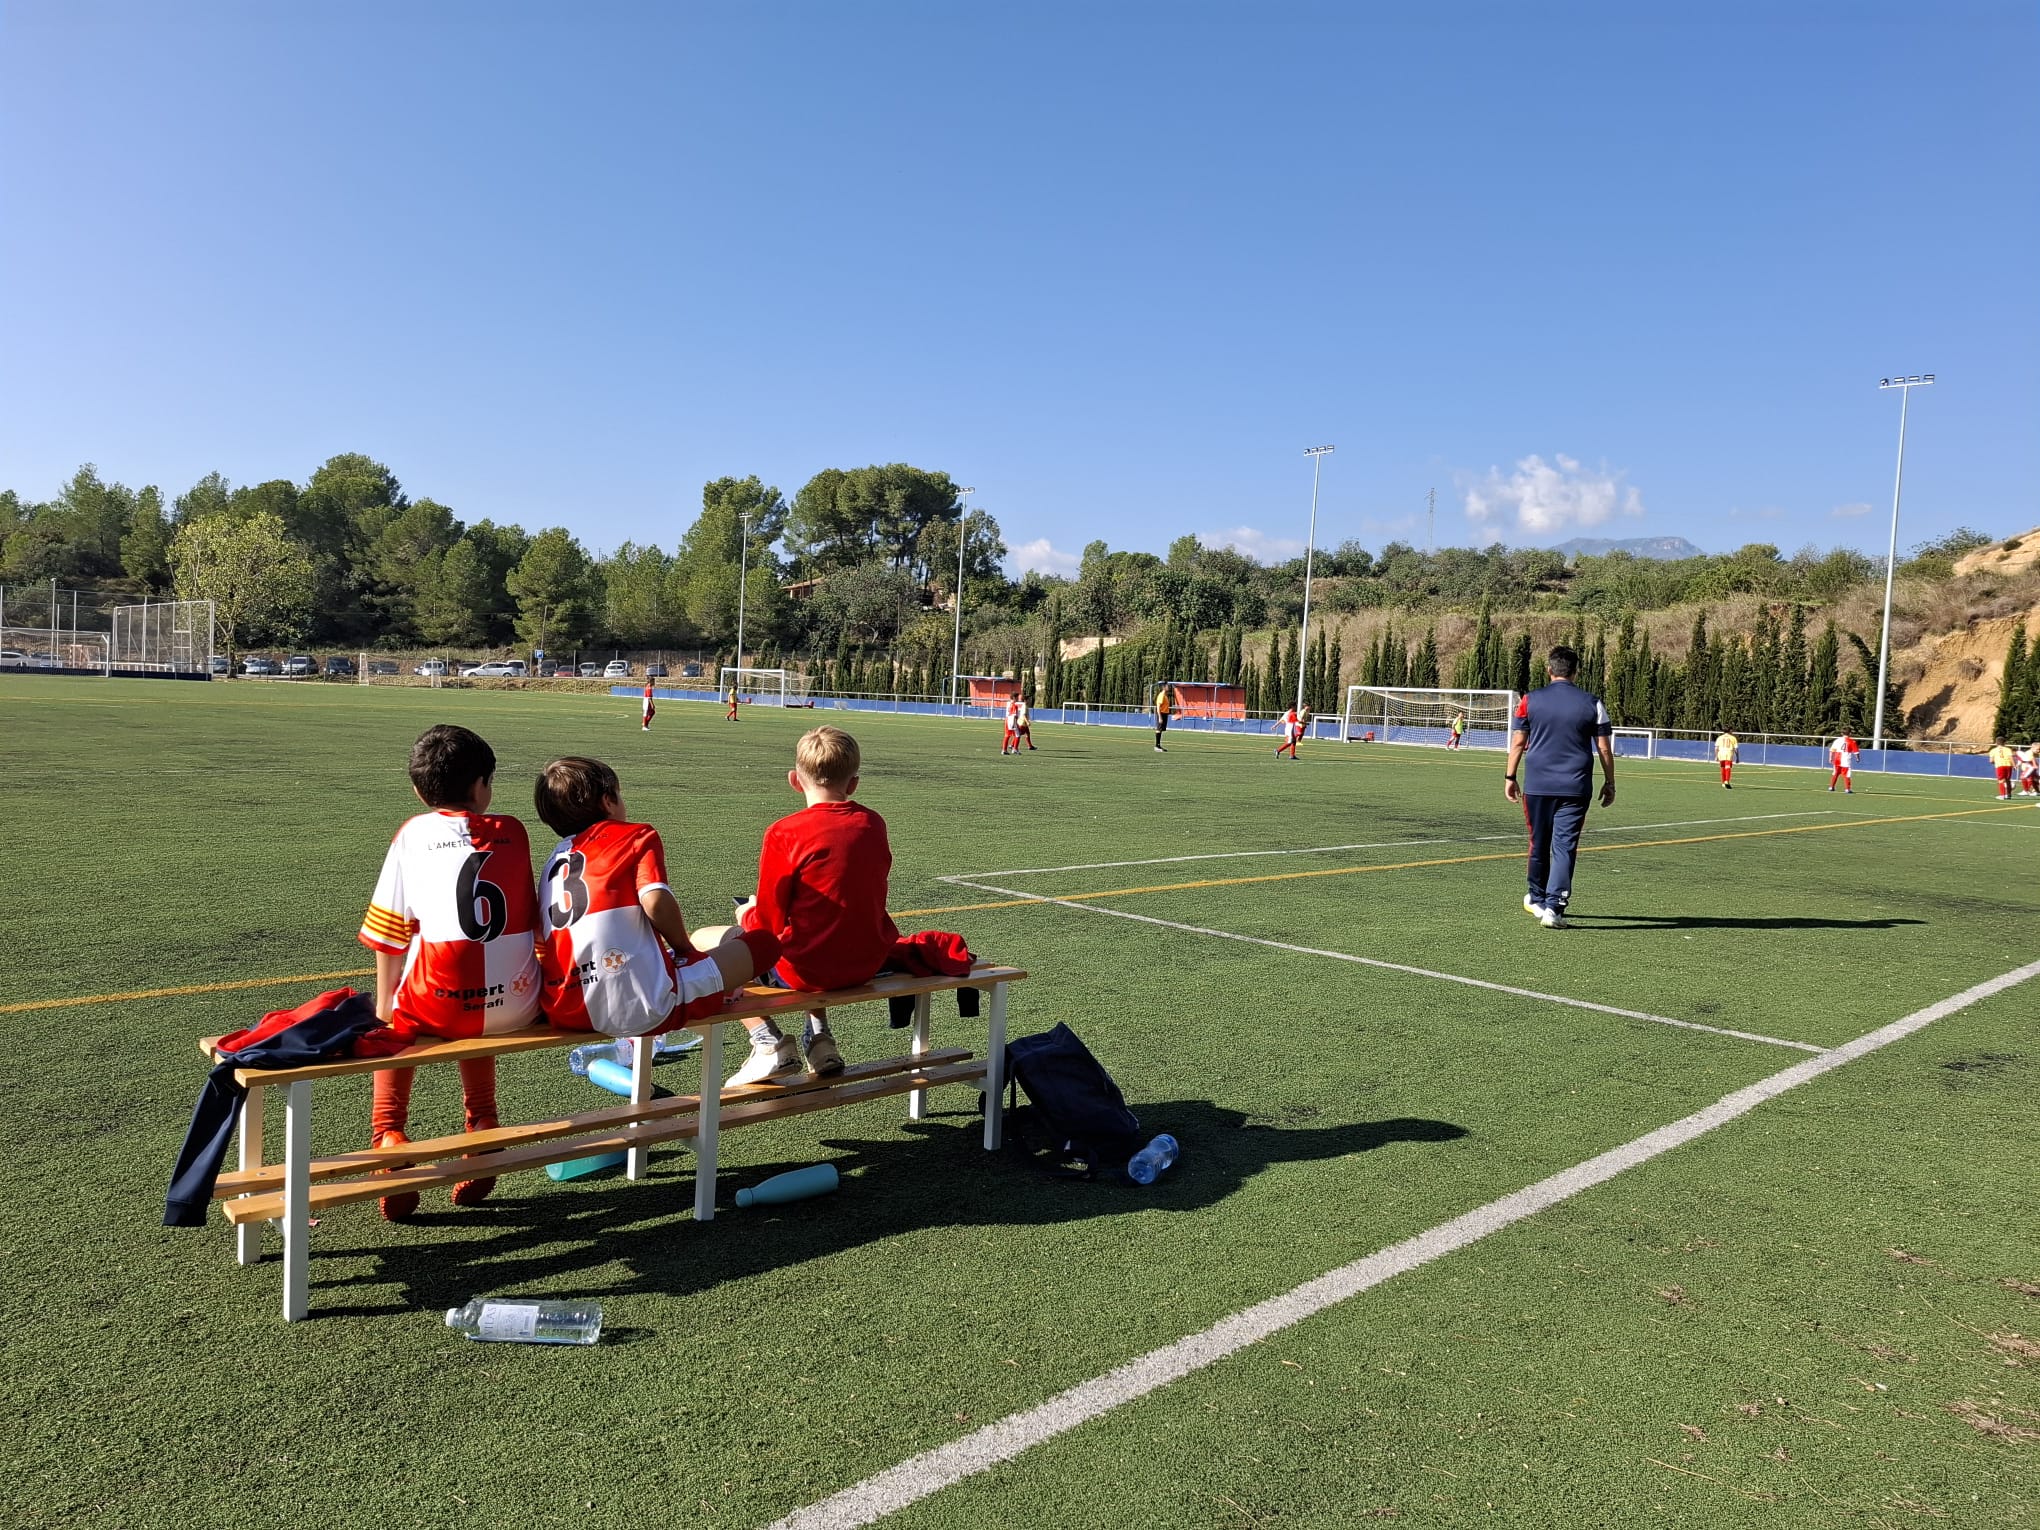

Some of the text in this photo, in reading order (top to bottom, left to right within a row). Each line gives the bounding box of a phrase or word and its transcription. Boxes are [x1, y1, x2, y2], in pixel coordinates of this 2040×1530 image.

[456, 851, 507, 943] 6
[547, 850, 590, 930] 3
[435, 983, 504, 1000] expert
[547, 961, 596, 986] exert
